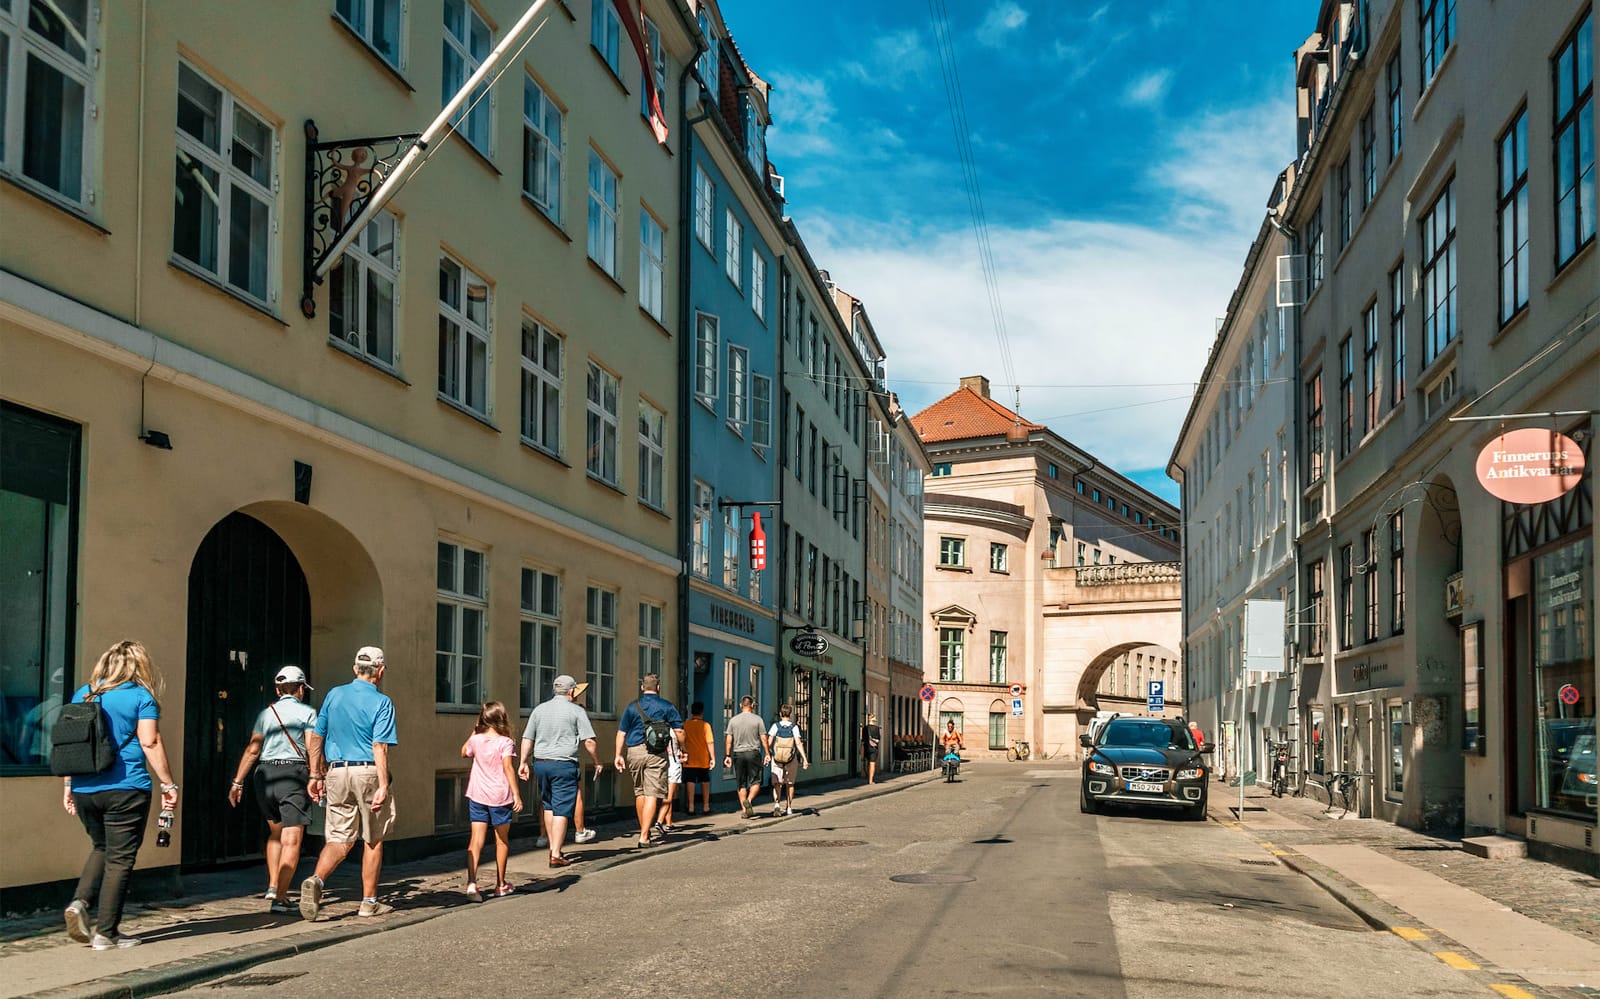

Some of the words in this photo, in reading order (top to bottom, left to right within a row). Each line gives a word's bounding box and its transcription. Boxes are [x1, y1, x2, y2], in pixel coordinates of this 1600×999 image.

[1493, 450, 1569, 464] Finnerups
[1486, 464, 1574, 480] Antikvariat
[1151, 682, 1161, 695] P
